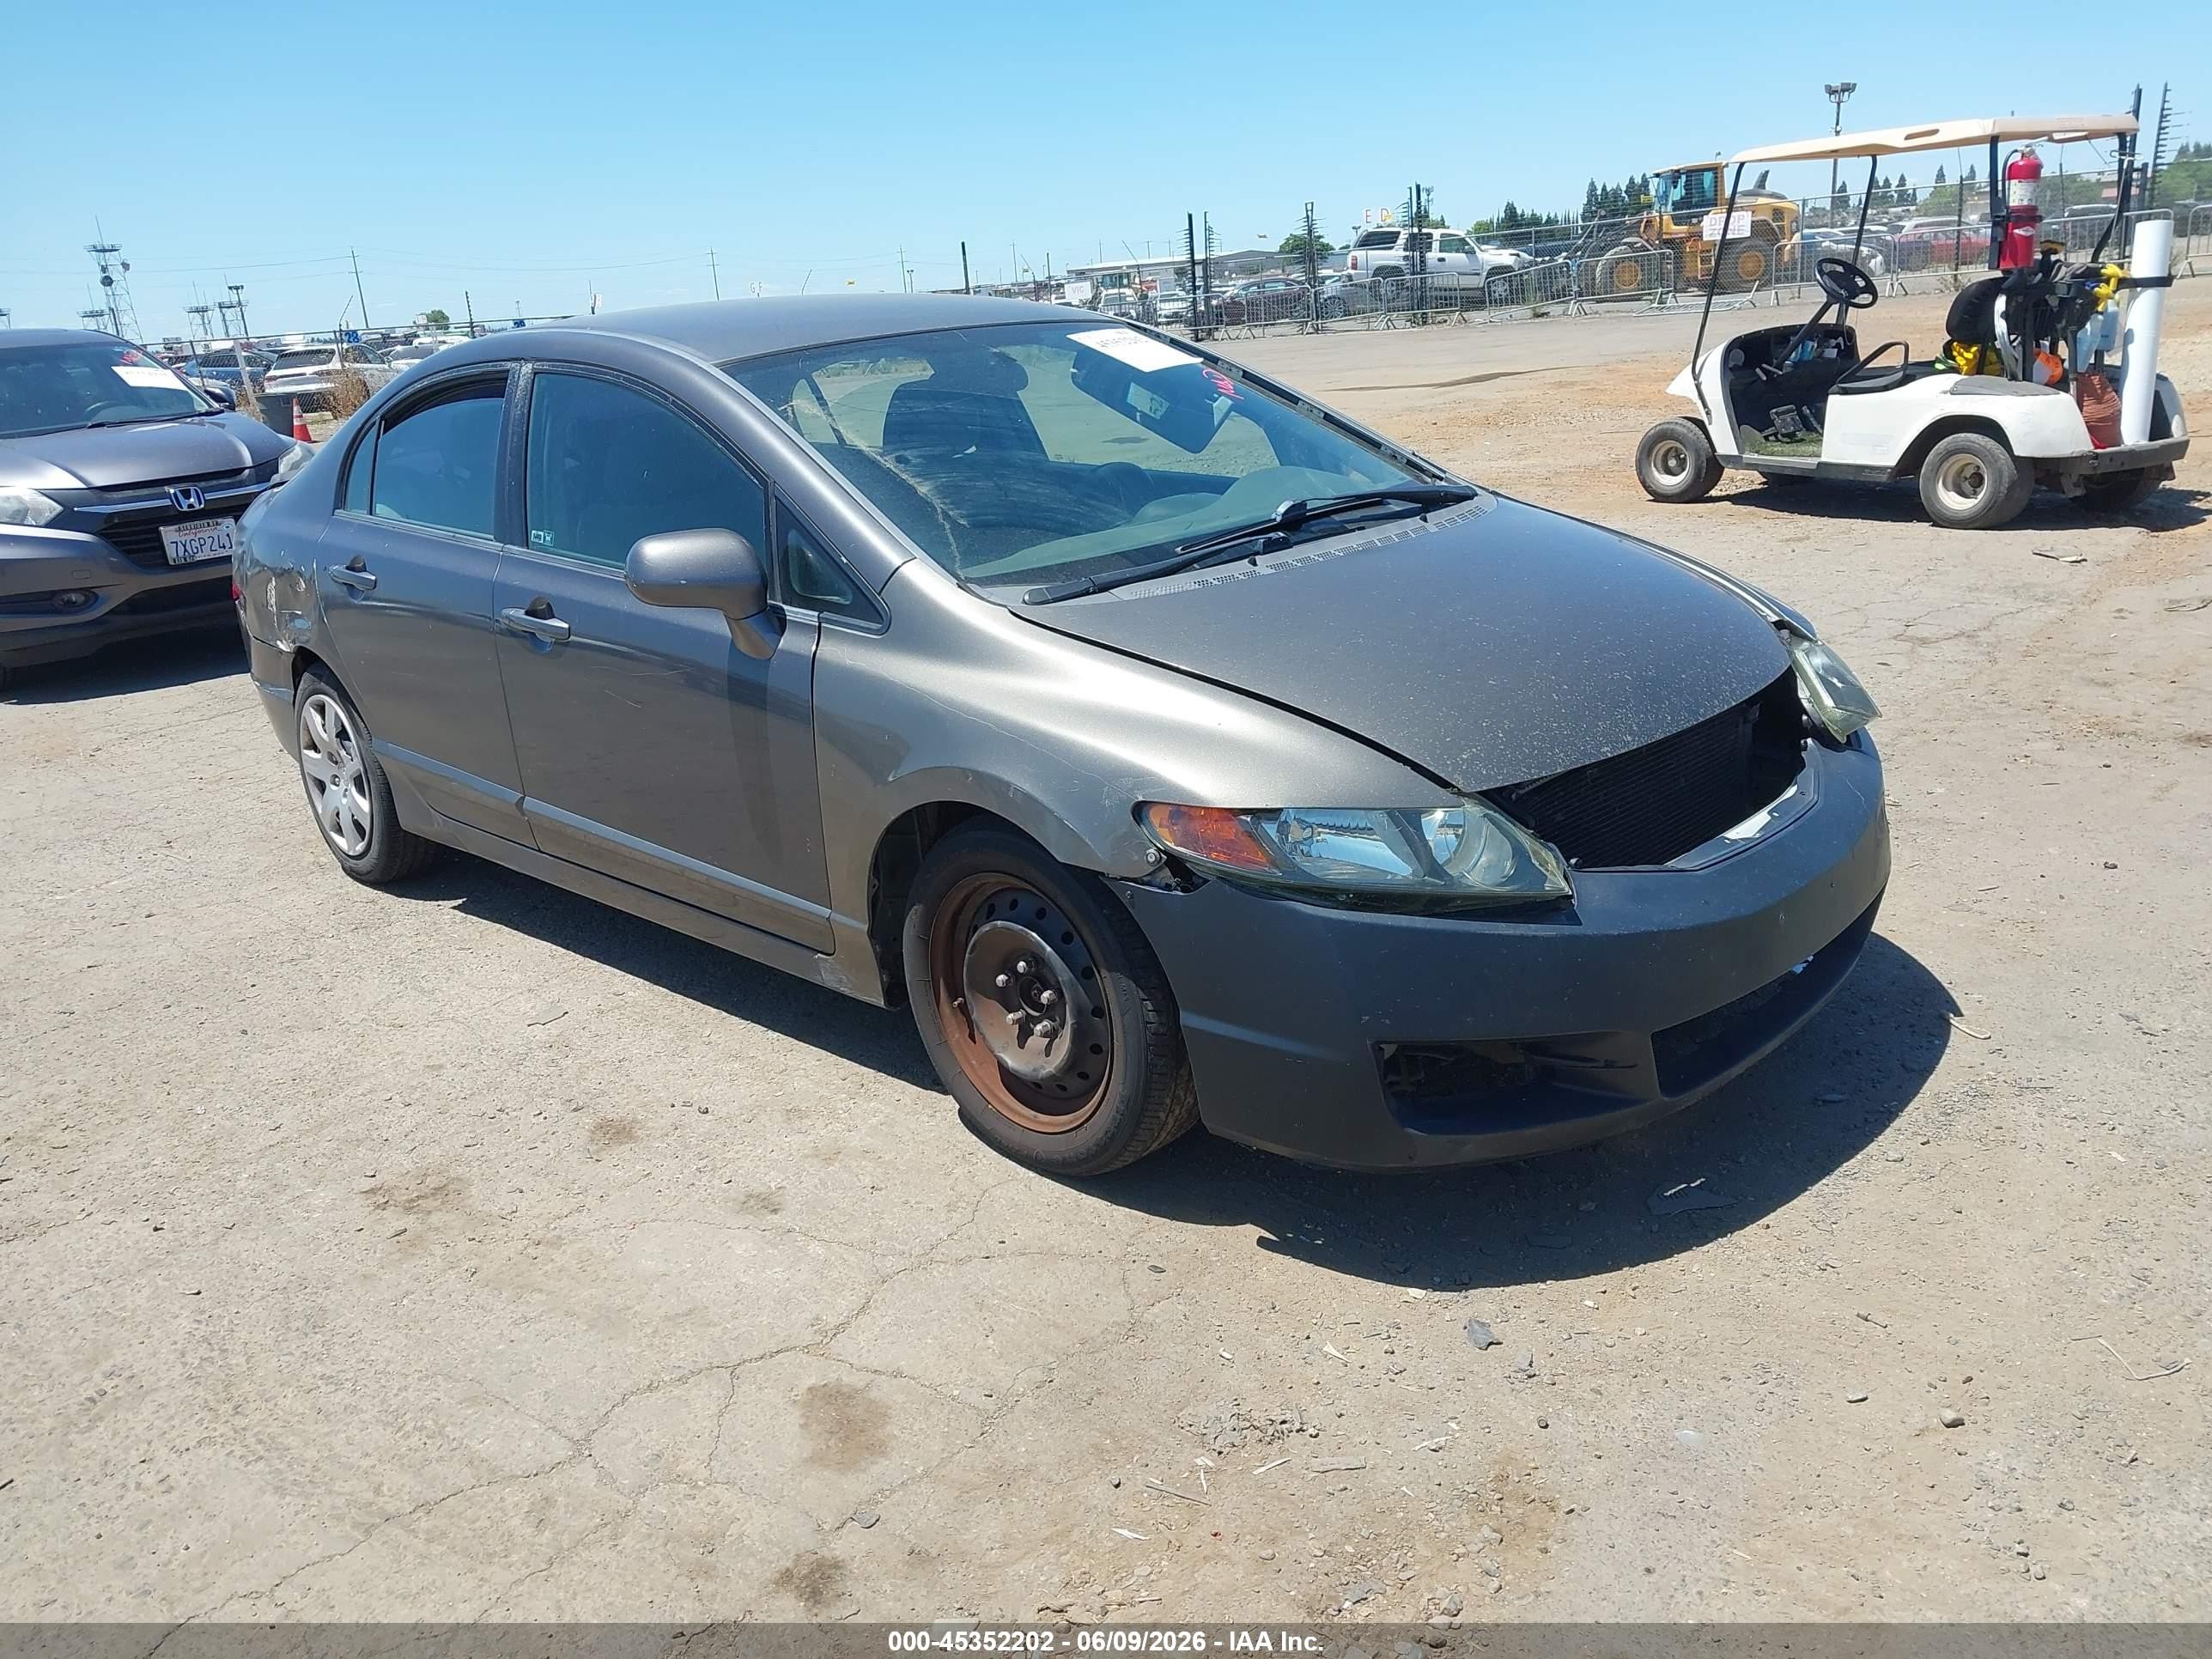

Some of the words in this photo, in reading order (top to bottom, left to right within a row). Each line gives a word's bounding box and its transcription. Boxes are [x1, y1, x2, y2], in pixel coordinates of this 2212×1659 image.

[1710, 214, 1746, 227] DROP
[1709, 225, 1747, 238] ZONE
[344, 331, 360, 343] 28
[170, 532, 234, 558] 7XGP241
